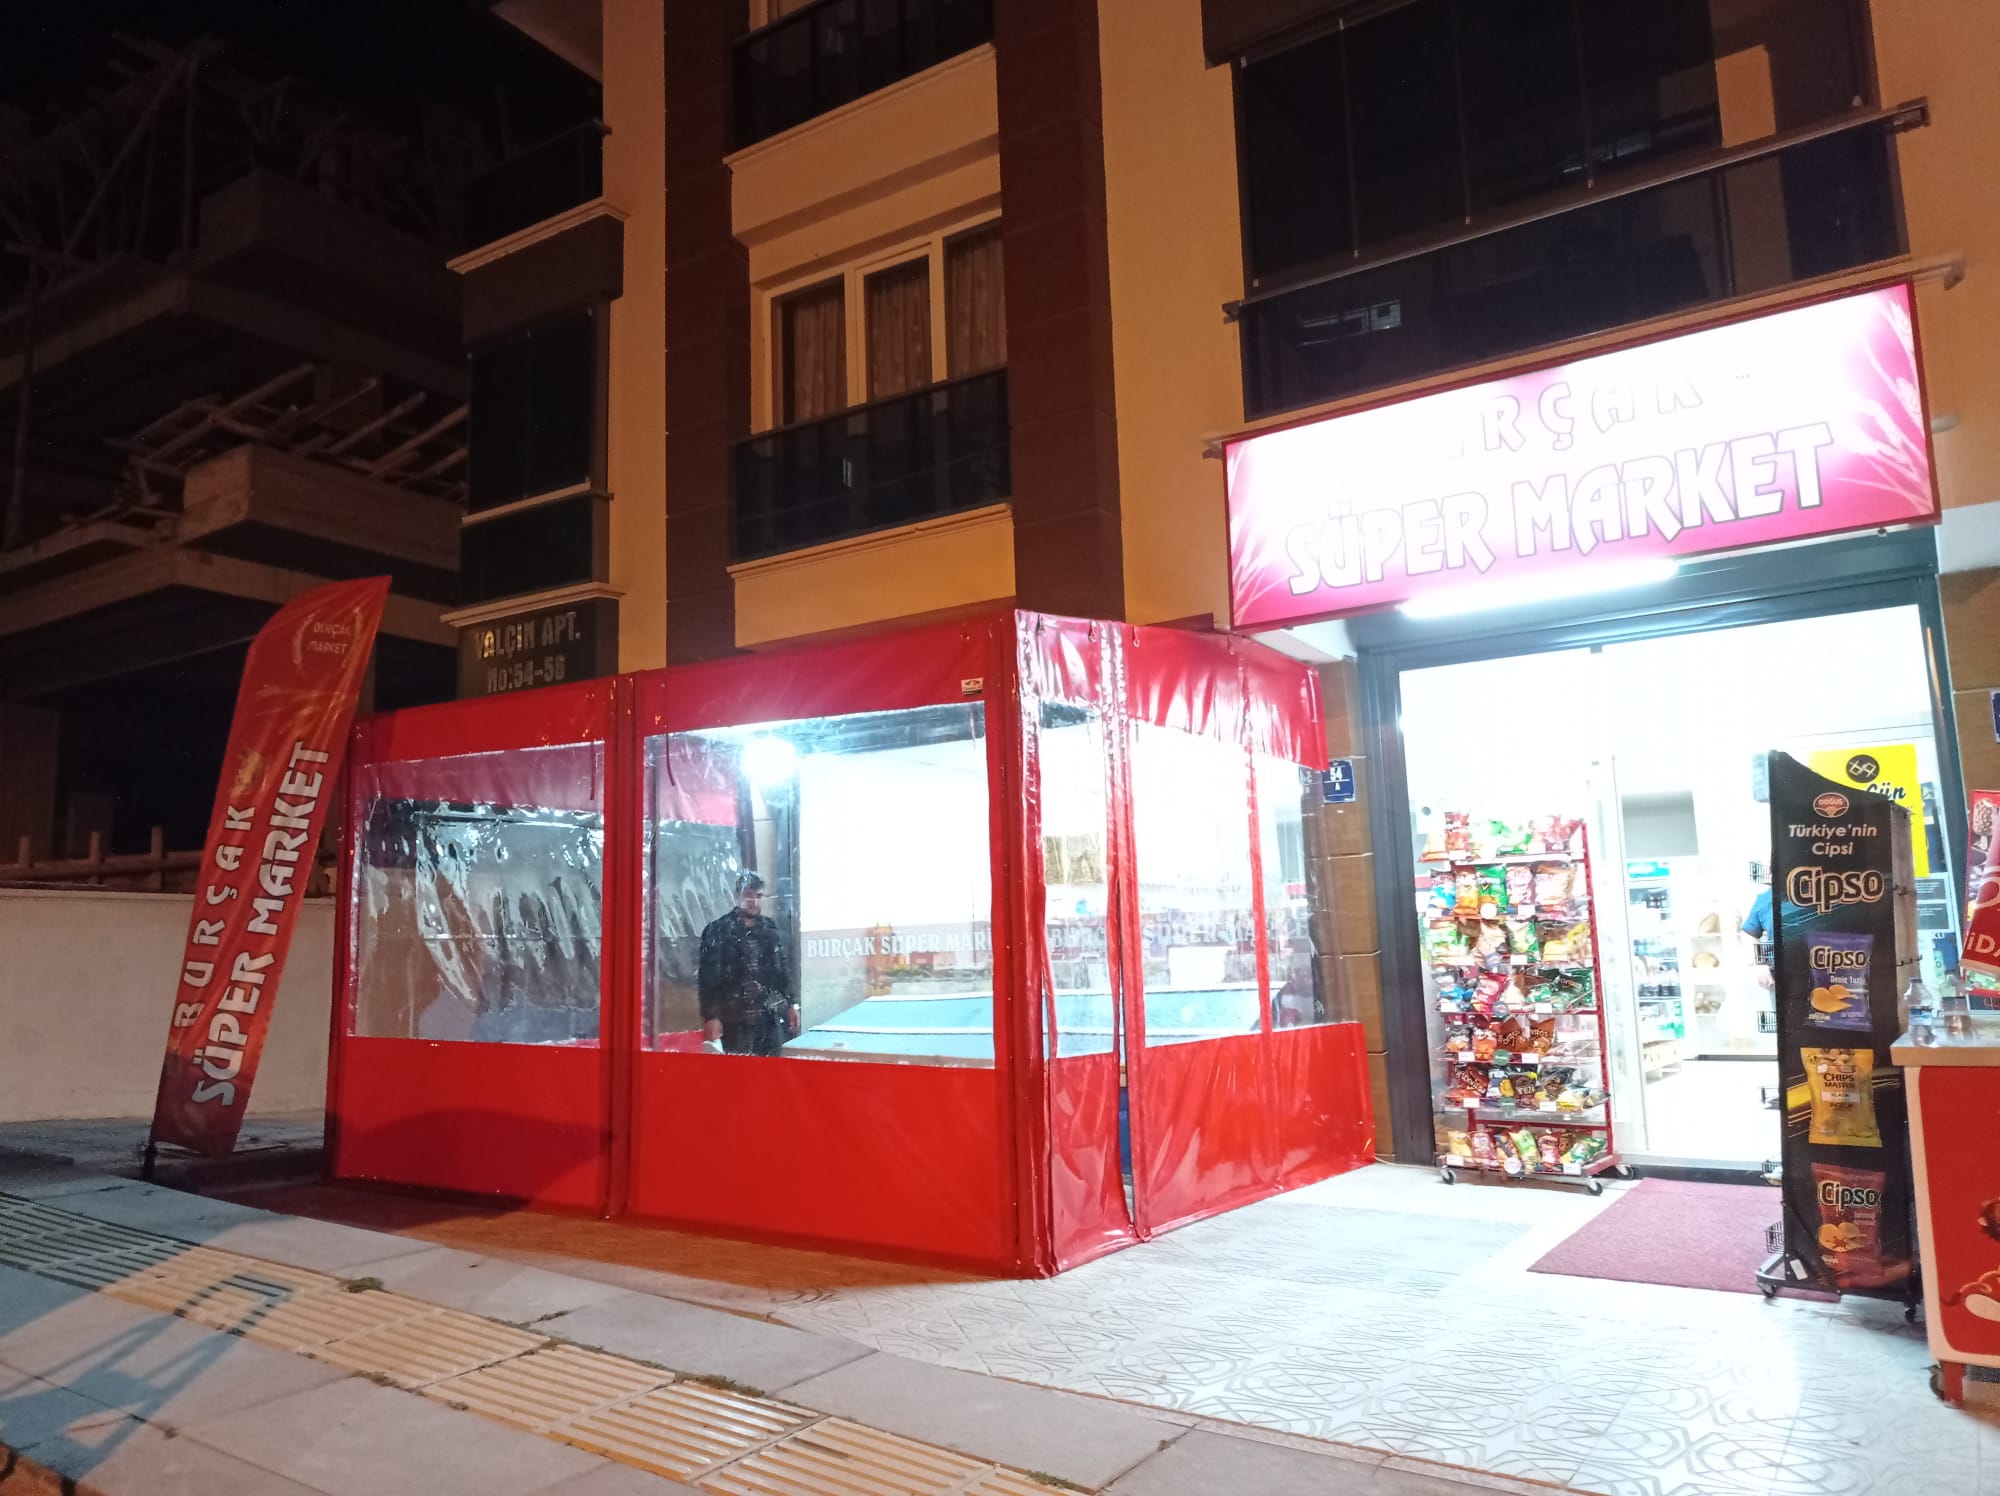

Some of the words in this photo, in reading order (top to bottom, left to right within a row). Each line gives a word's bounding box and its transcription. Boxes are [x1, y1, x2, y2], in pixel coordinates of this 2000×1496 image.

[1286, 490, 1496, 596] SÜPER
[1511, 421, 1834, 557] MARKET
[542, 611, 581, 647] APT.
[307, 641, 348, 654] MARKET
[1330, 766, 1343, 782] 54
[1788, 824, 1877, 840] Türkiye'nin
[1812, 842, 1853, 858] Cipsi
[1786, 866, 1885, 915] Cipso
[173, 805, 256, 1028] BURÇAK
[191, 951, 275, 1107] SÜPER
[247, 741, 329, 936] MARKET
[807, 936, 876, 962] BURÇAK
[1810, 945, 1868, 974] Cipso
[1823, 1073, 1854, 1082] CHIPS
[1824, 1081, 1855, 1089] MASTER
[1817, 1180, 1881, 1213] Cipso
